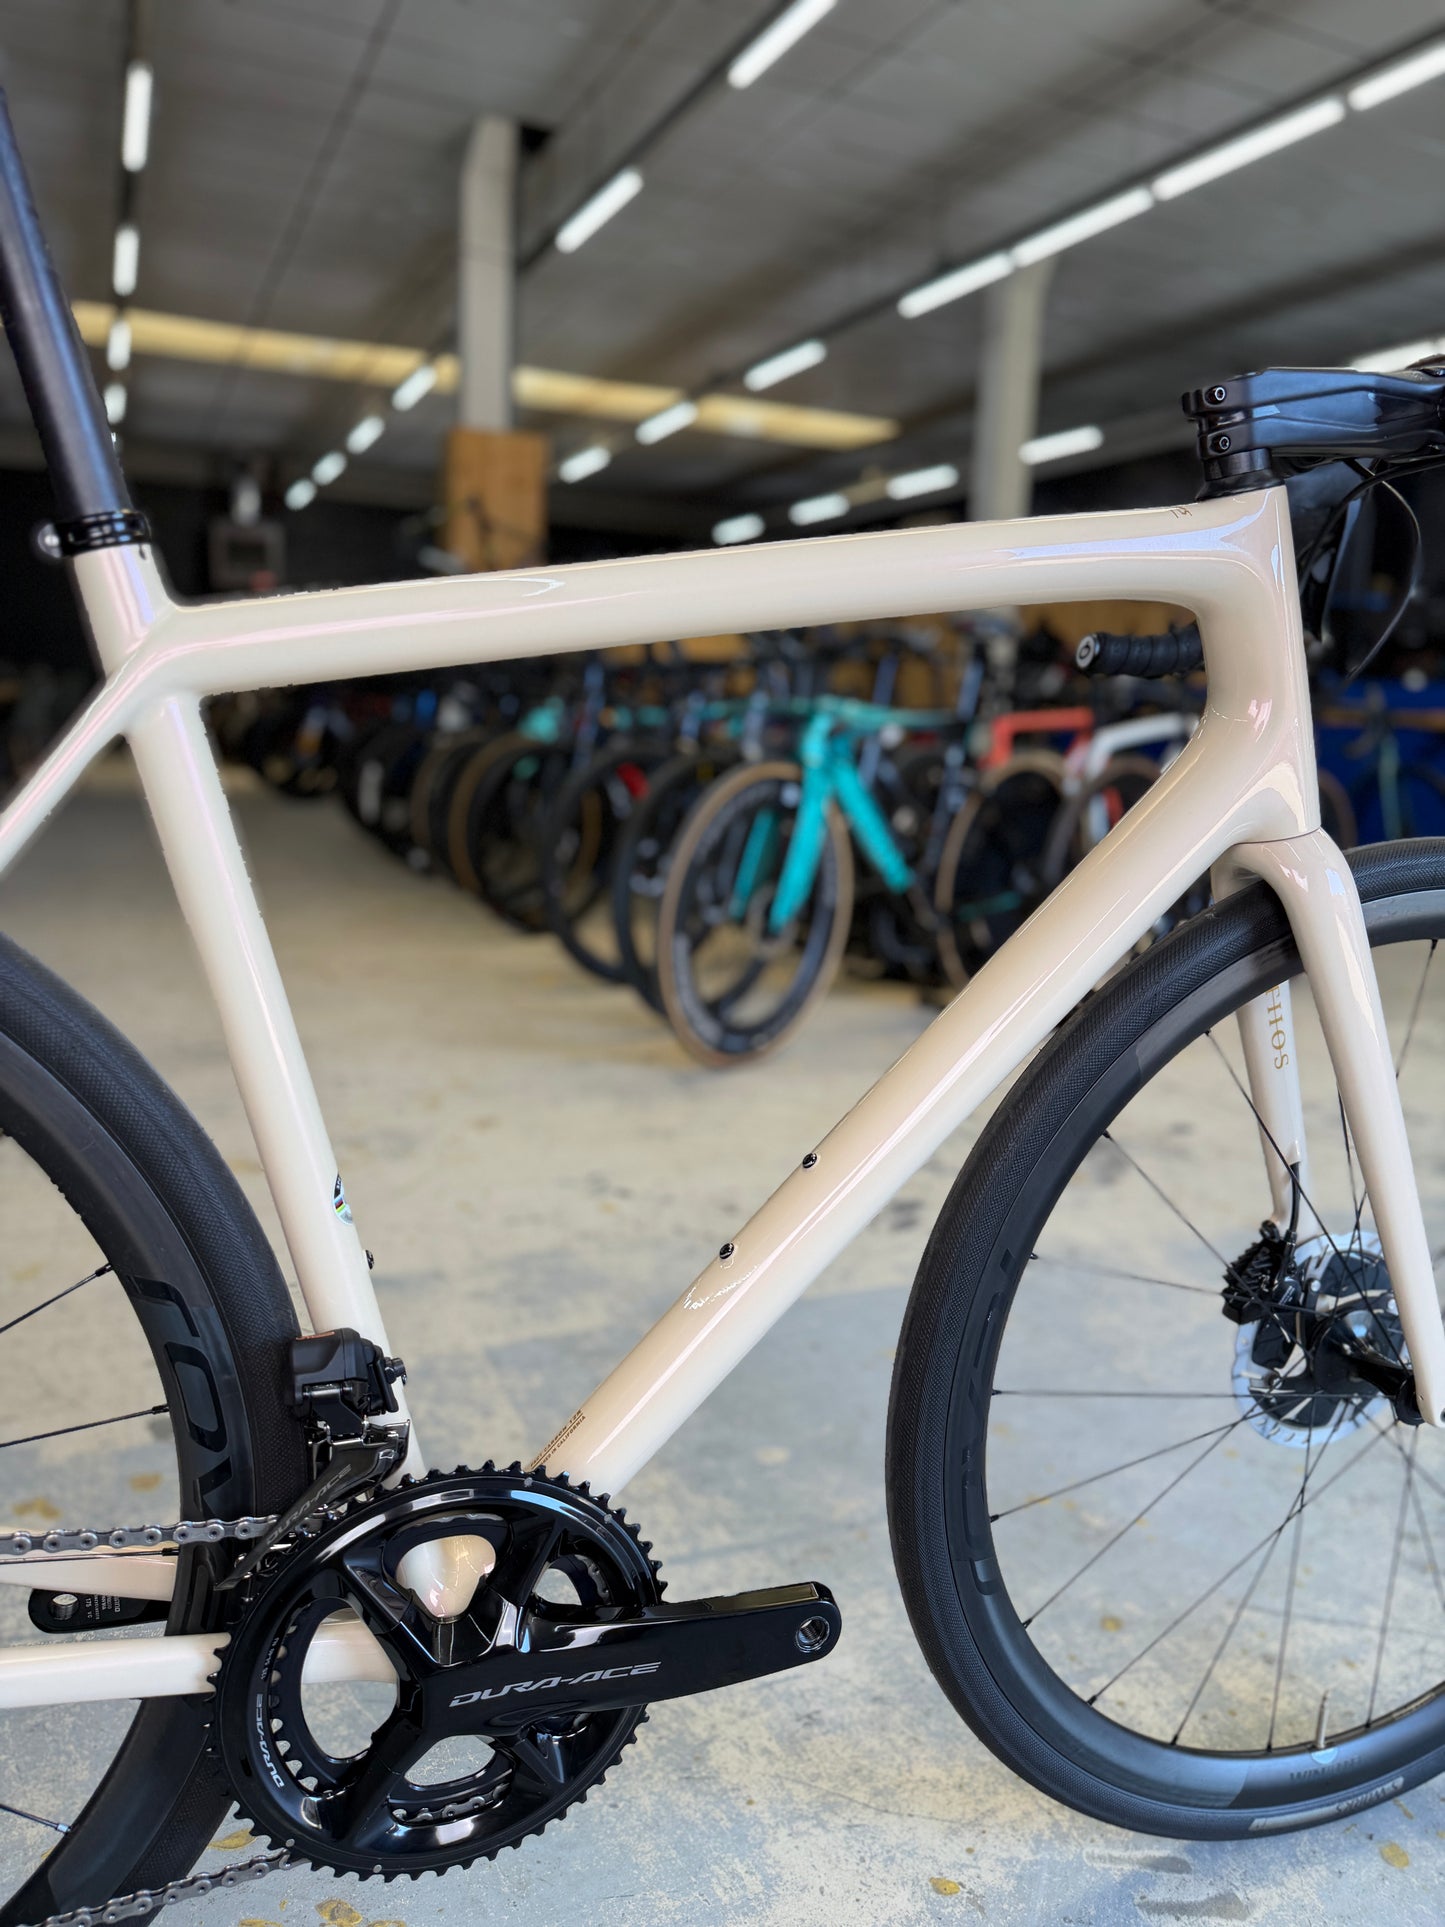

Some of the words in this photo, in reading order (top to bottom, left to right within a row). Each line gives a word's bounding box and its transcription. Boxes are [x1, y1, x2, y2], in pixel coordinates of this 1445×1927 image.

[1264, 984, 1290, 1070] THOS
[557, 1415, 586, 1448] CALIFORNIA
[266, 1463, 352, 1545] DURA-ACE
[449, 1661, 662, 1708] DURA-ACE
[256, 1693, 285, 1789] DURA-ACE
